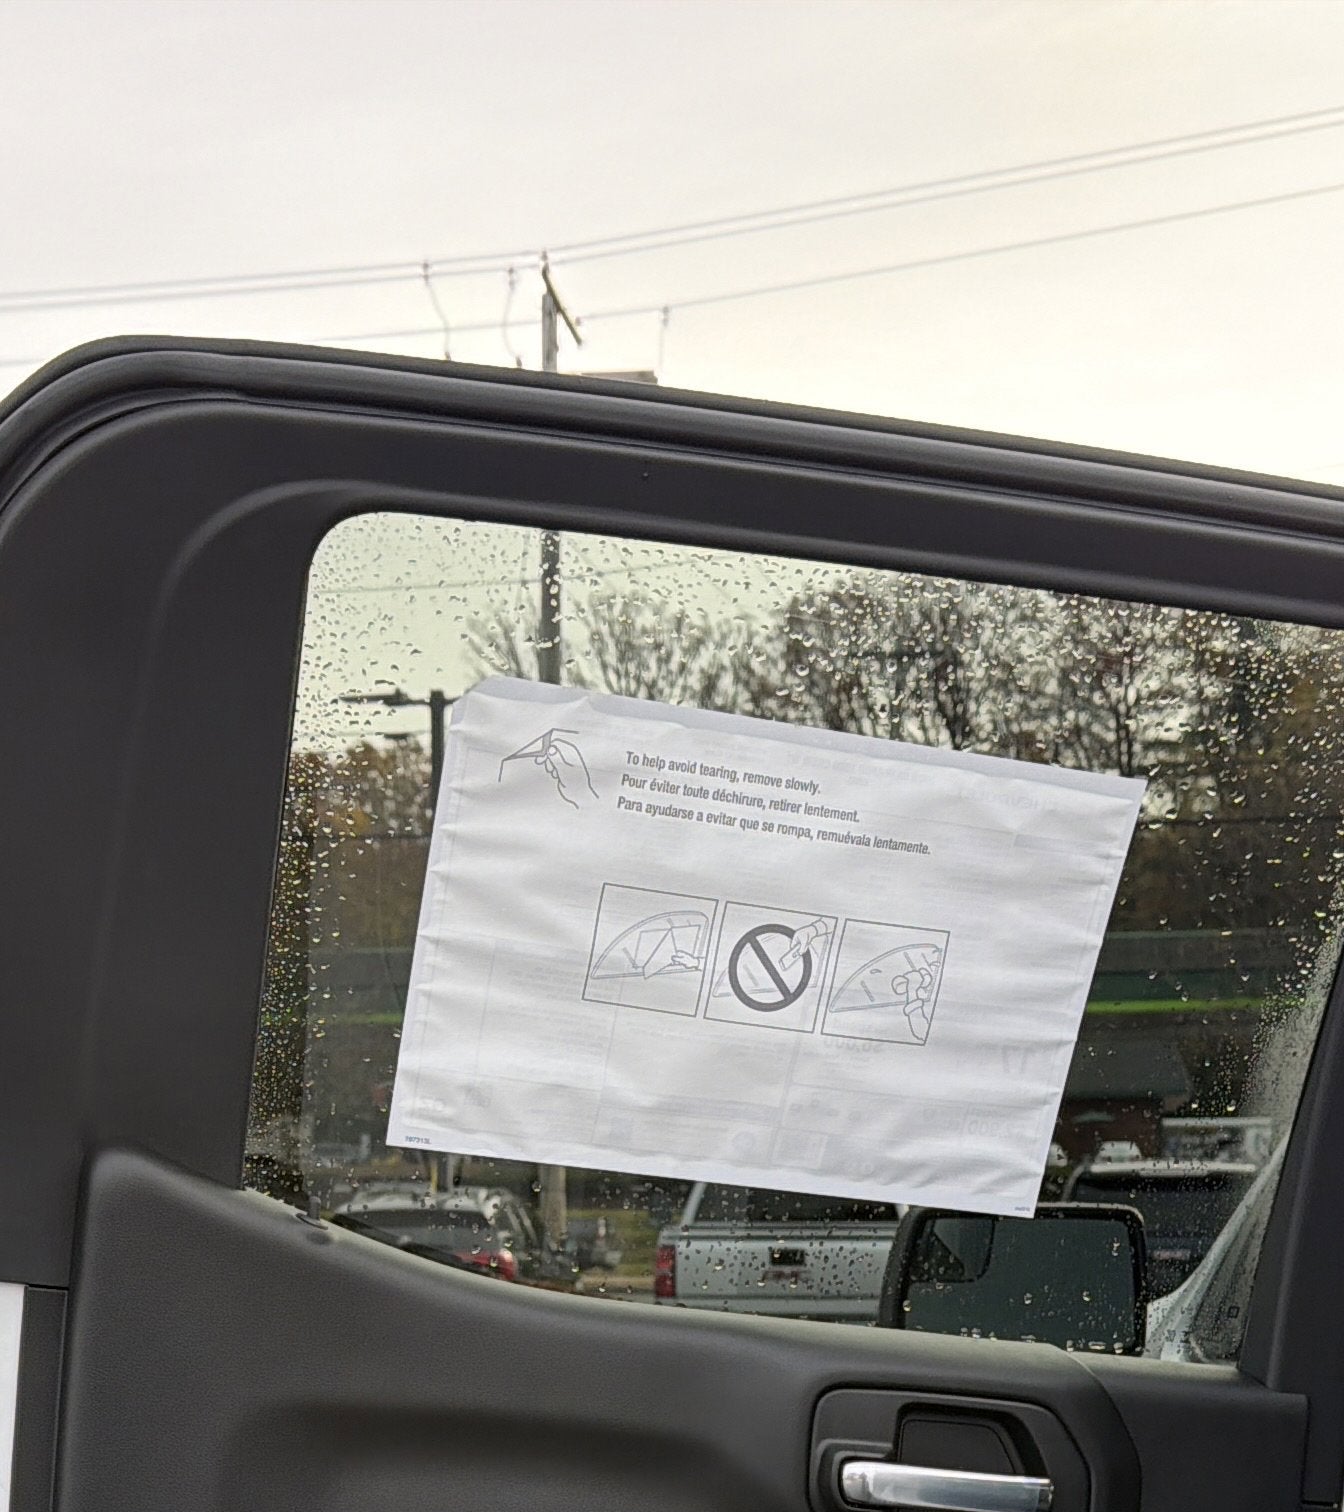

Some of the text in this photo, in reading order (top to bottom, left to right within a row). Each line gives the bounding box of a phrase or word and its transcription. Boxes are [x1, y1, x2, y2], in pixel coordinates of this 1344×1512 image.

[621, 773, 860, 823] Pour éviter toute déchirure, retirer lentement.
[626, 751, 821, 796] To help avoid tearing, remove slowly.
[617, 795, 931, 856] Para ayudarse a evitar que se rompa, remuévala lentamente.
